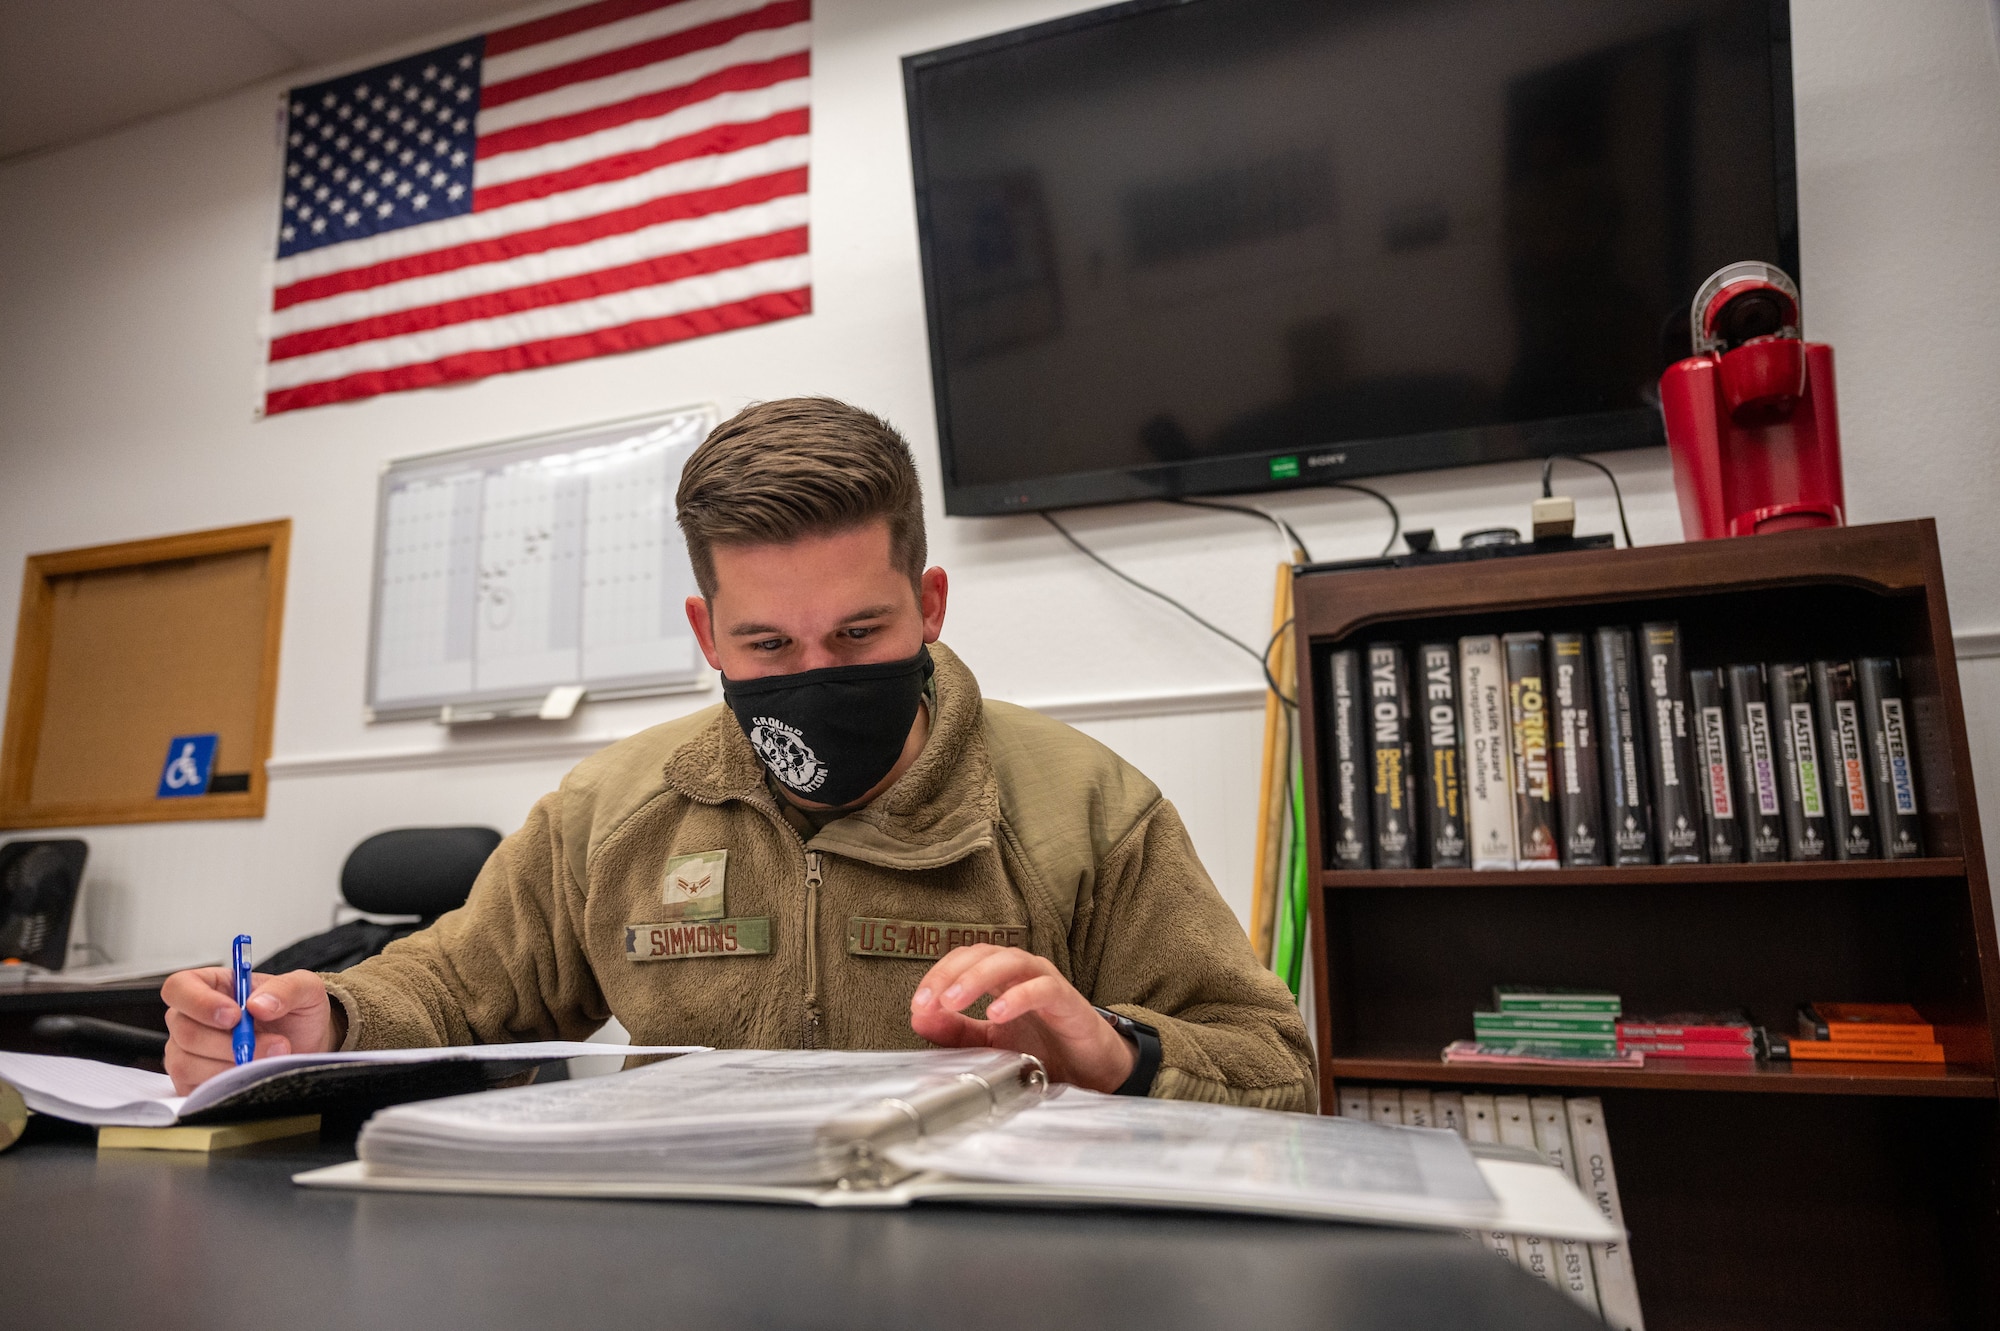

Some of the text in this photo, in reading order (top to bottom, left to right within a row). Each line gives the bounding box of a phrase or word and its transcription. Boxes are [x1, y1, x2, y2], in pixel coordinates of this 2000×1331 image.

[1371, 649, 1399, 742] EYE ON
[1427, 651, 1455, 745] EYE ON
[1557, 665, 1575, 706] Cargo
[1651, 654, 1668, 696] Cargo
[752, 717, 804, 737] GROUND
[1335, 698, 1352, 760] Perception
[1468, 667, 1489, 800] Perception Challenge
[1485, 686, 1503, 781] Forklift Hazard
[1521, 677, 1550, 801] FORKLIFT
[1561, 709, 1581, 794] Securement
[1577, 710, 1588, 728] Dry
[1657, 699, 1679, 786] Securement
[1674, 701, 1686, 737] Flatbed
[1375, 749, 1388, 794] Driving
[1386, 749, 1402, 809] Defensive
[1515, 756, 1526, 794] Training
[1624, 741, 1638, 806] INTERSECTIONS
[1706, 714, 1728, 813] MASTERDRIVER
[1750, 709, 1774, 810] MASTERDRIVER
[1795, 710, 1819, 812] MASTERDRIVER
[1840, 707, 1865, 810] MASTERDRIVER
[1885, 705, 1912, 809] MASTERDRIVER
[650, 924, 738, 956] SIMMONS
[859, 923, 901, 952] U.S.
[905, 926, 940, 956] AIR
[1589, 1154, 1605, 1188] CDL
